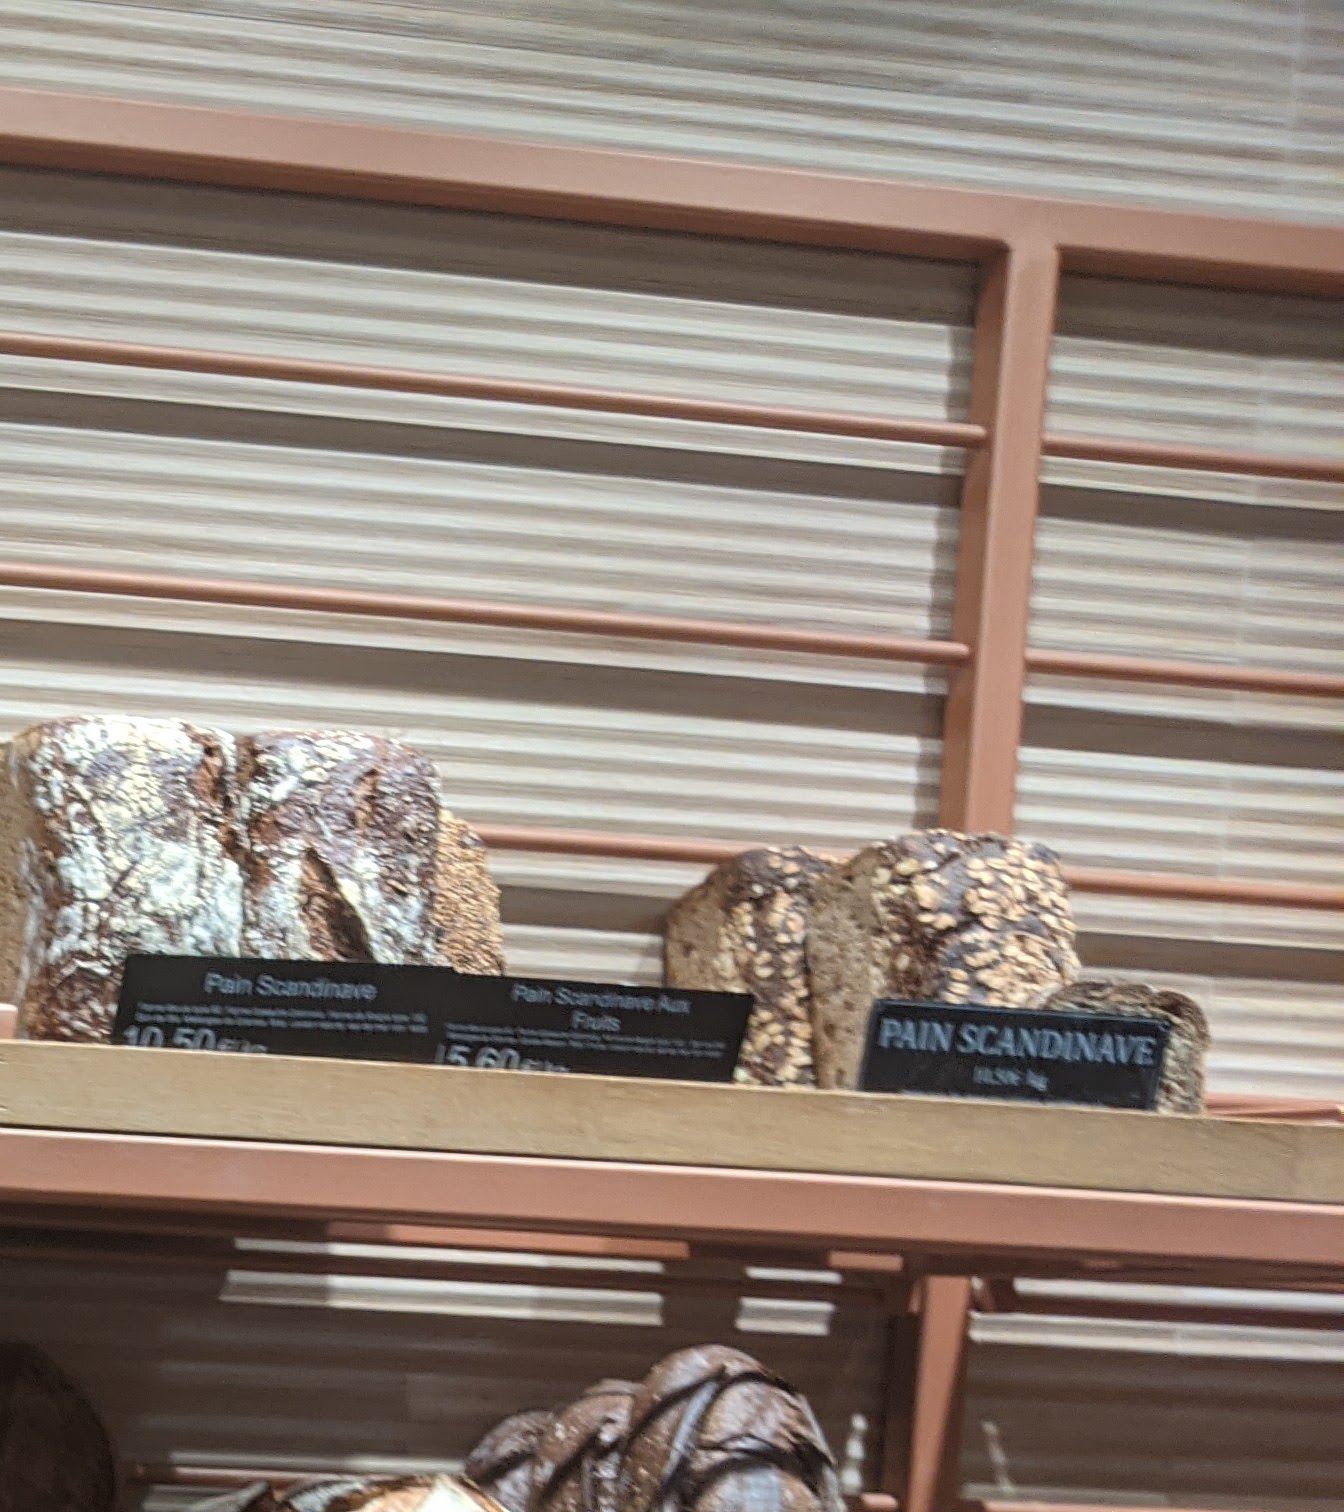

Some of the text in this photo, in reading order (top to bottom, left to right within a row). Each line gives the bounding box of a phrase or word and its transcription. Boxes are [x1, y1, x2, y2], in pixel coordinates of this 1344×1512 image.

[203, 971, 379, 1001] Pain Scandinave
[512, 982, 552, 1005] Pain
[877, 1016, 1158, 1067] PAIN SCANDINAVE
